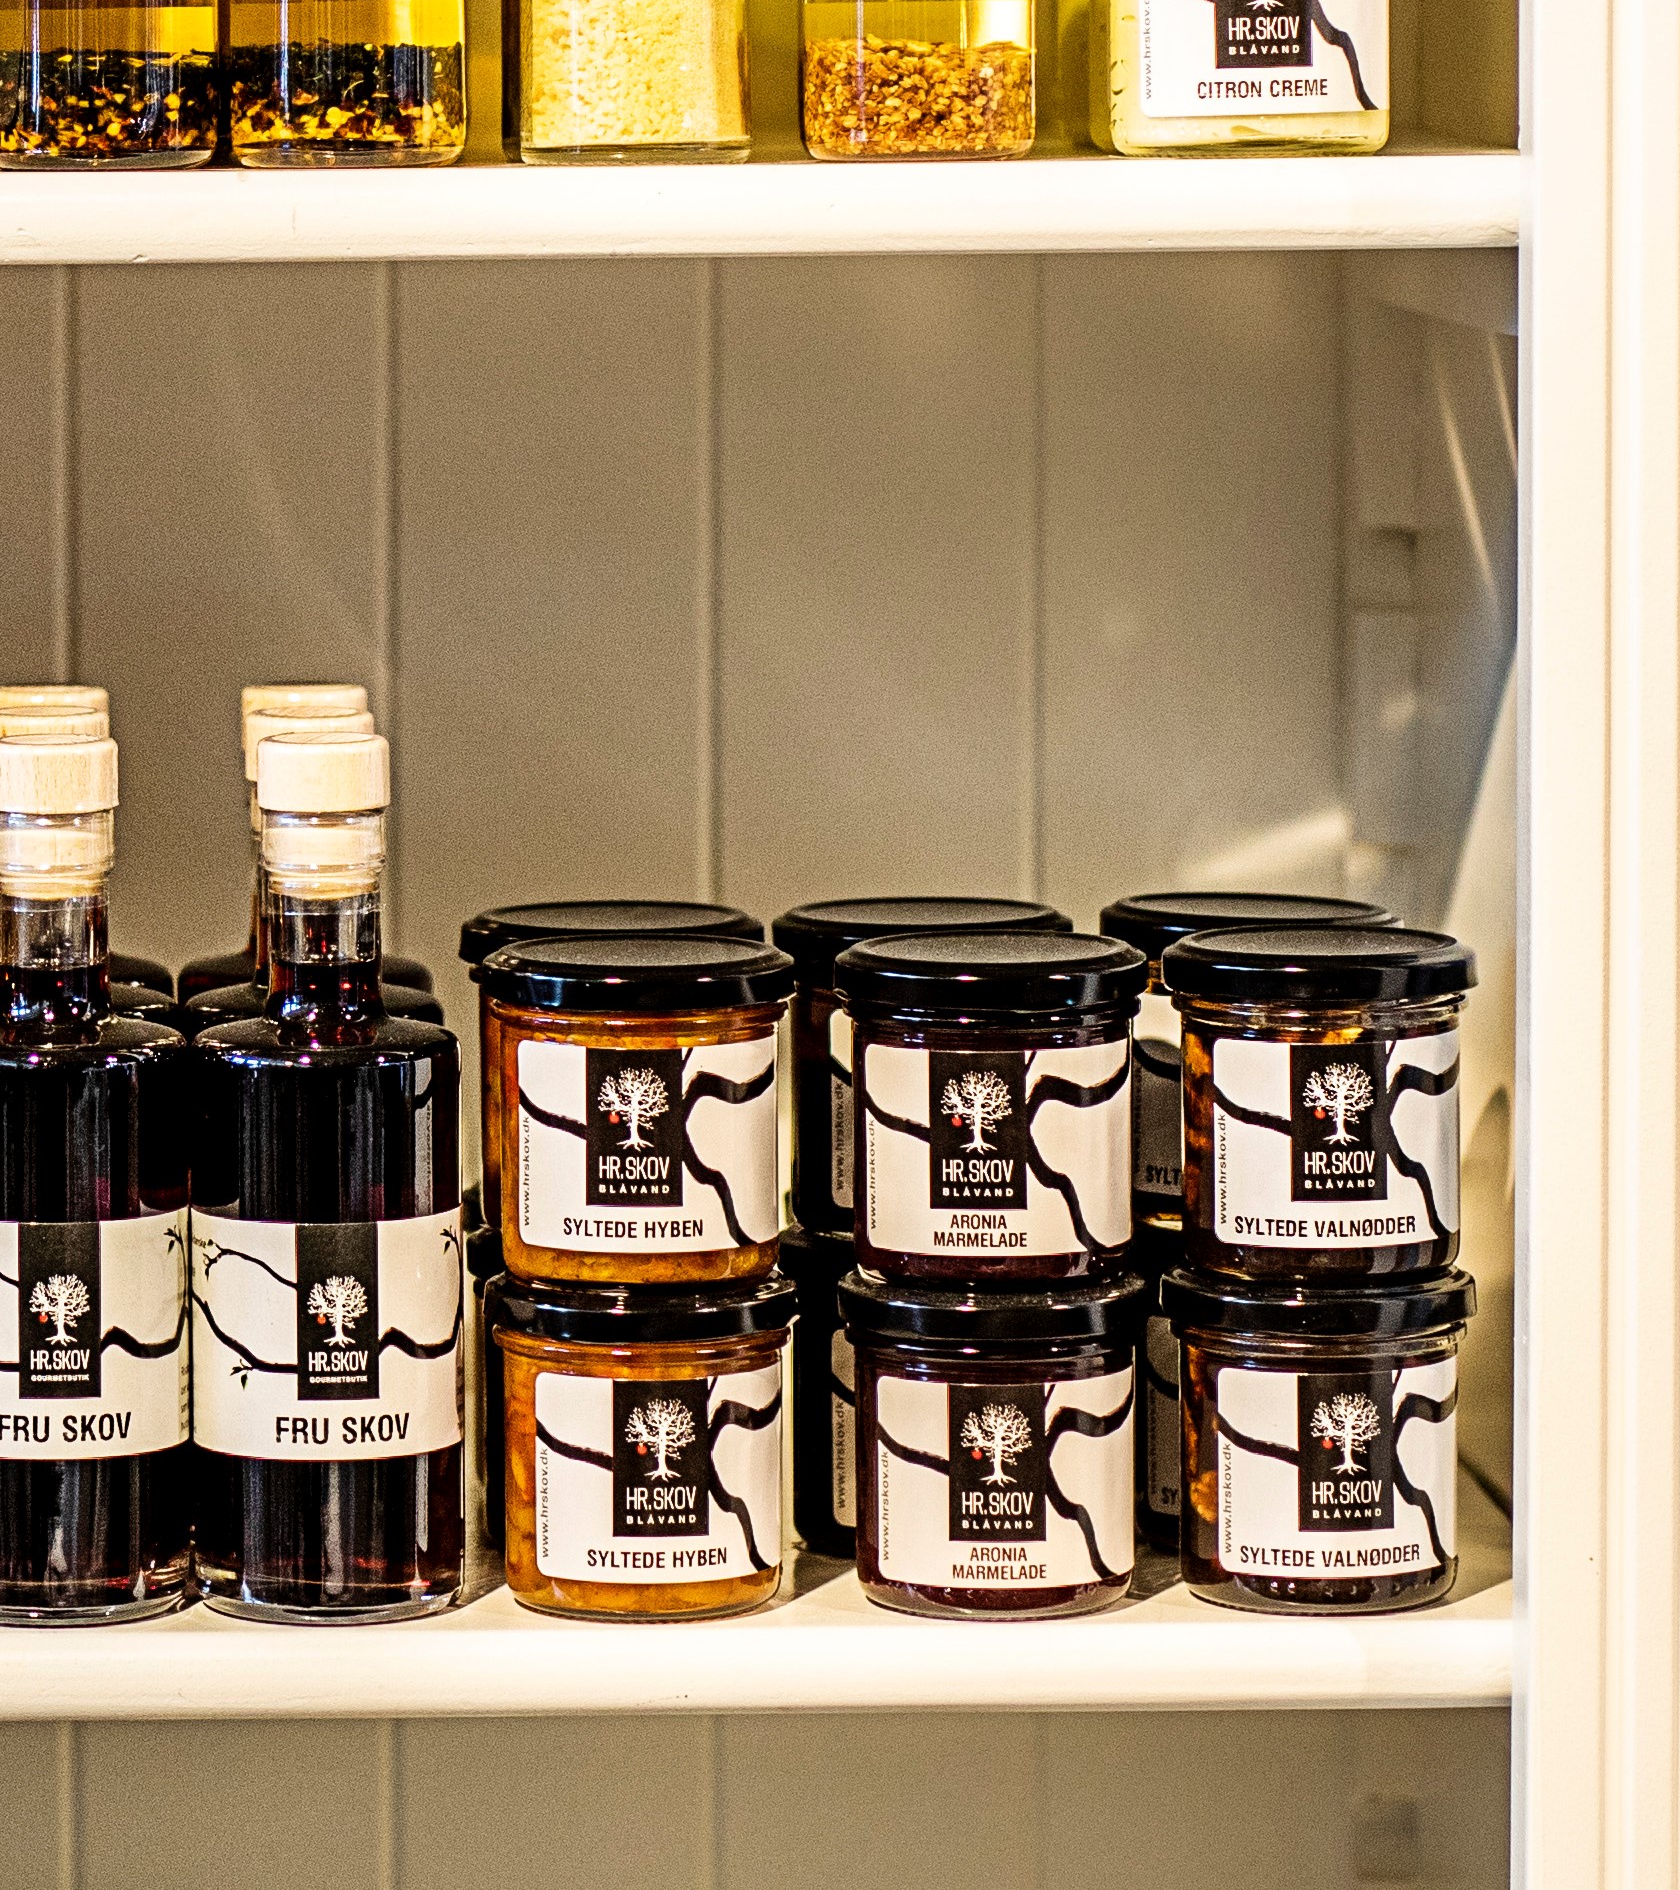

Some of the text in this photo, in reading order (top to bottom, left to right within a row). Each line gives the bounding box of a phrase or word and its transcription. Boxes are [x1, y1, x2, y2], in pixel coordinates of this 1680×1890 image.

[1197, 78, 1328, 100] CITRON CREME
[563, 1217, 704, 1239] SYLTEDE HYBEN
[950, 1213, 1008, 1230] ARONIA
[1234, 1215, 1416, 1238] SYLTEDE VALNØDDER
[933, 1230, 1028, 1248] MARMELADE
[308, 1350, 369, 1372] HR.SKOV
[275, 1412, 410, 1445] FRU SKOV
